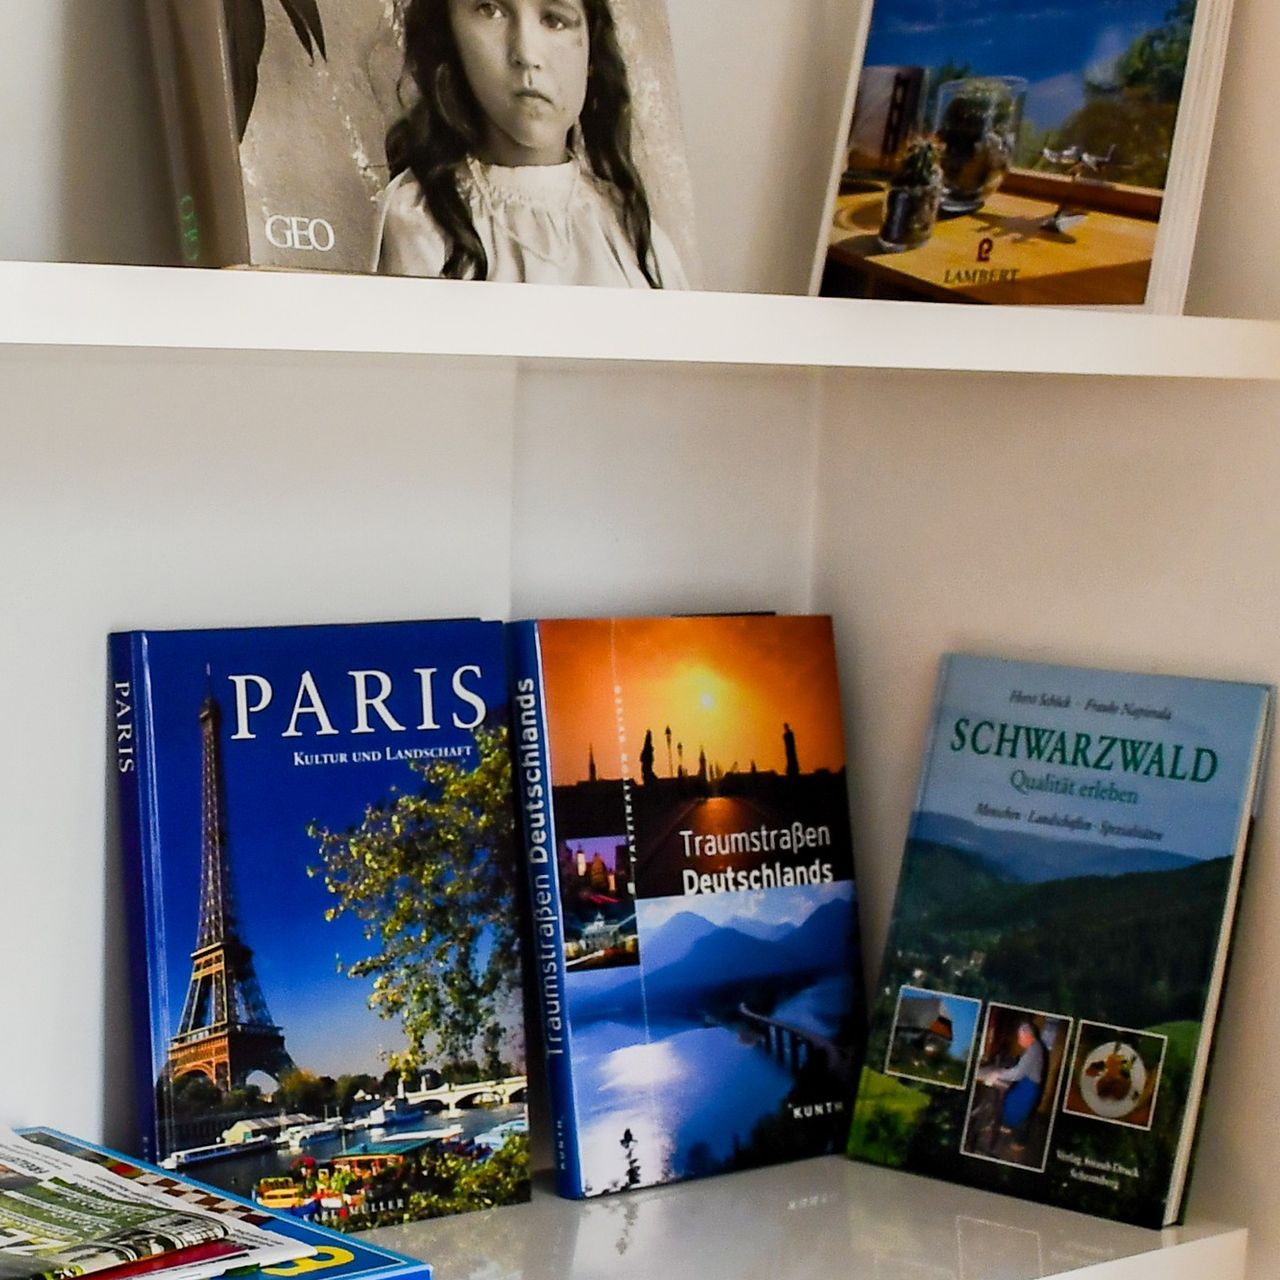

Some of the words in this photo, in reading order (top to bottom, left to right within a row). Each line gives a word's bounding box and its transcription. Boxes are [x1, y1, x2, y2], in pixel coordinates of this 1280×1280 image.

[265, 214, 335, 252] GEO
[943, 268, 1020, 283] LAMBERT
[228, 664, 488, 740] PARIS
[114, 681, 135, 774] PARIS
[293, 751, 348, 766] KULTUR
[352, 750, 382, 762] UND
[386, 745, 473, 761] LANDSCHAFT
[950, 718, 1219, 783] SCHWARZWALD
[517, 678, 549, 864] Deutschlands
[1009, 769, 1074, 796] Qualität
[1079, 780, 1139, 805] erleben
[679, 821, 831, 858] Traumstraßen
[682, 860, 833, 896] Deutschlands
[531, 873, 563, 1055] Traumstraßen
